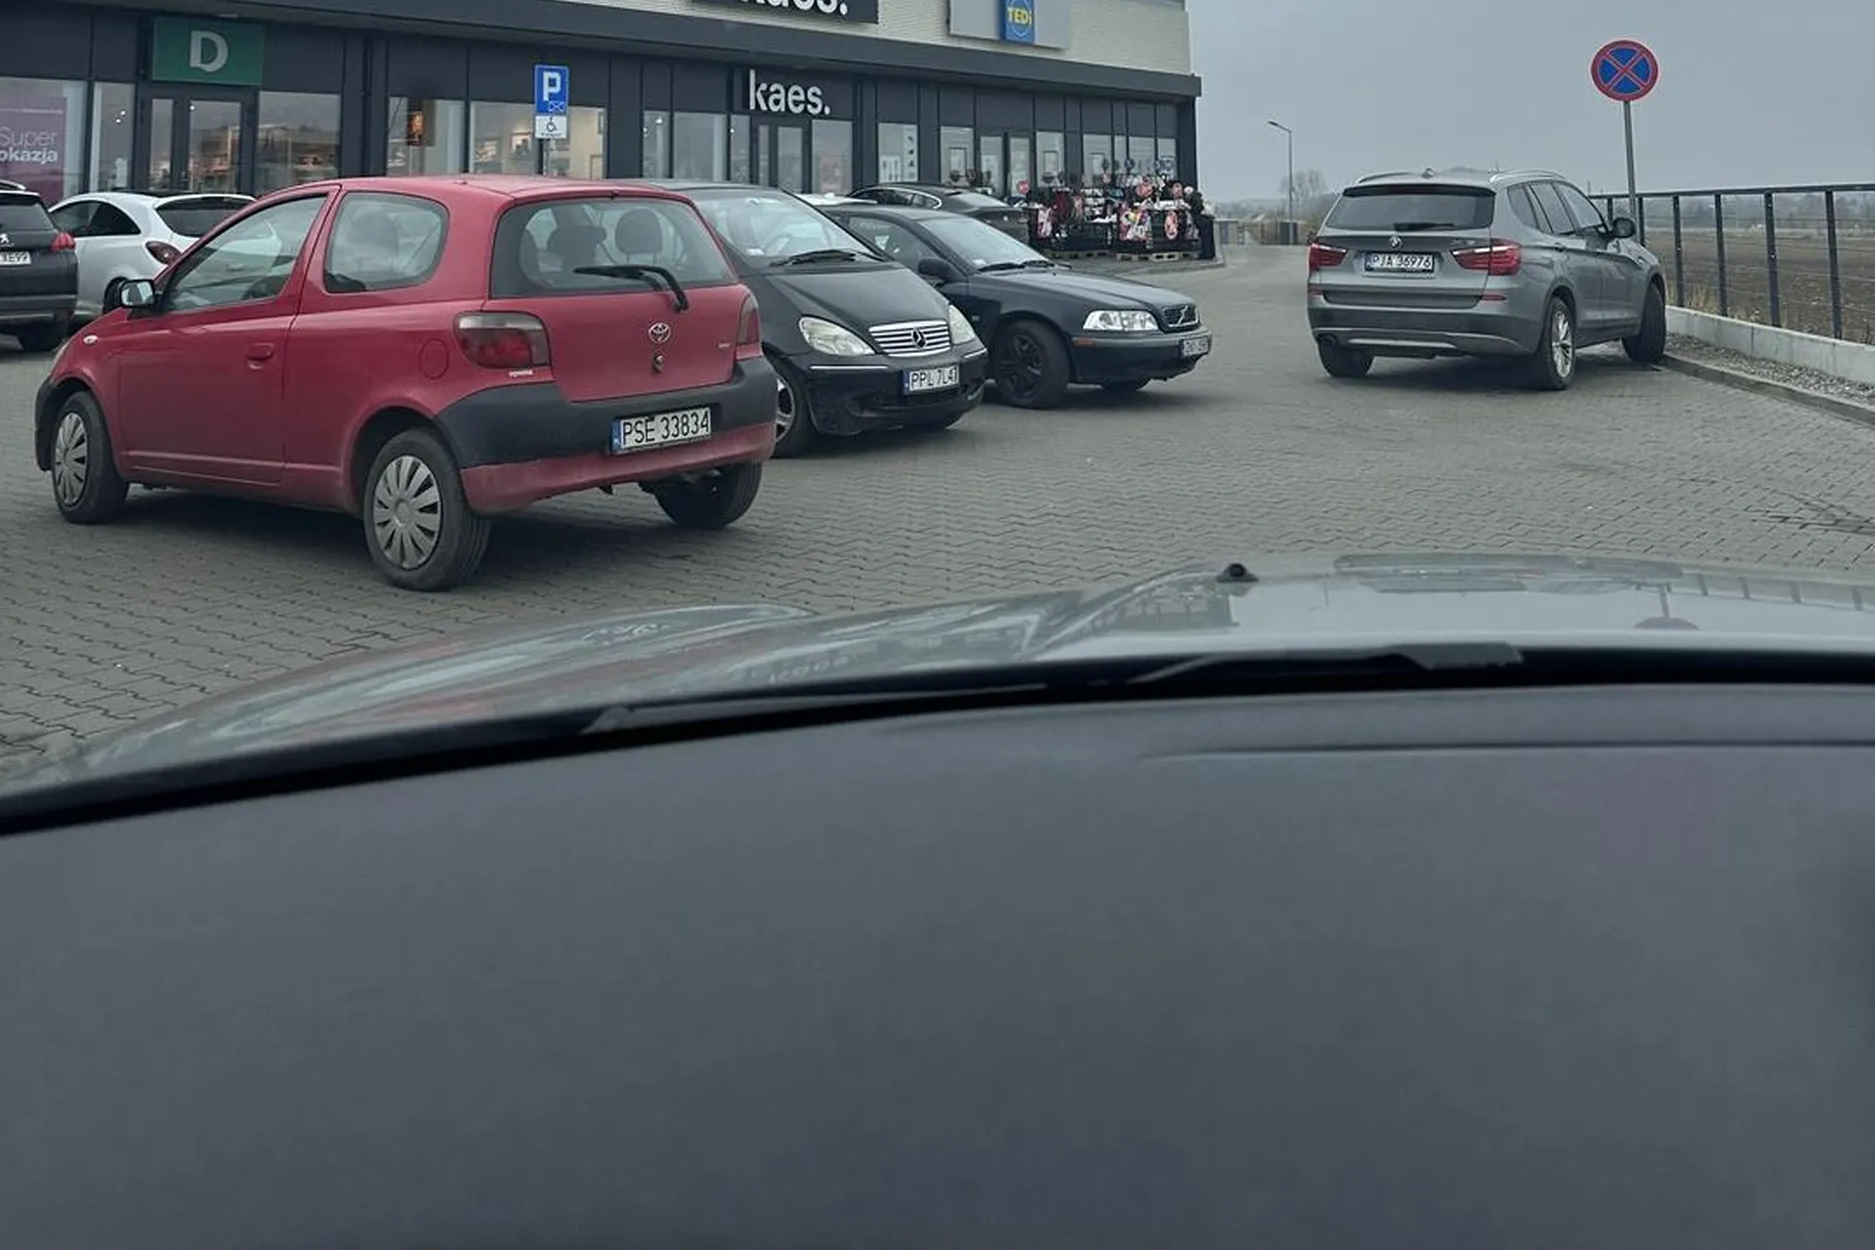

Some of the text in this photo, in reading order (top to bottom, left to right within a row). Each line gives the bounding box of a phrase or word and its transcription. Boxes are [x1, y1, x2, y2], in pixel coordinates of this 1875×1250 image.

[189, 30, 229, 72] D
[543, 71, 561, 101] P
[749, 69, 831, 115] kaes.
[623, 410, 710, 446] PSE 33834
